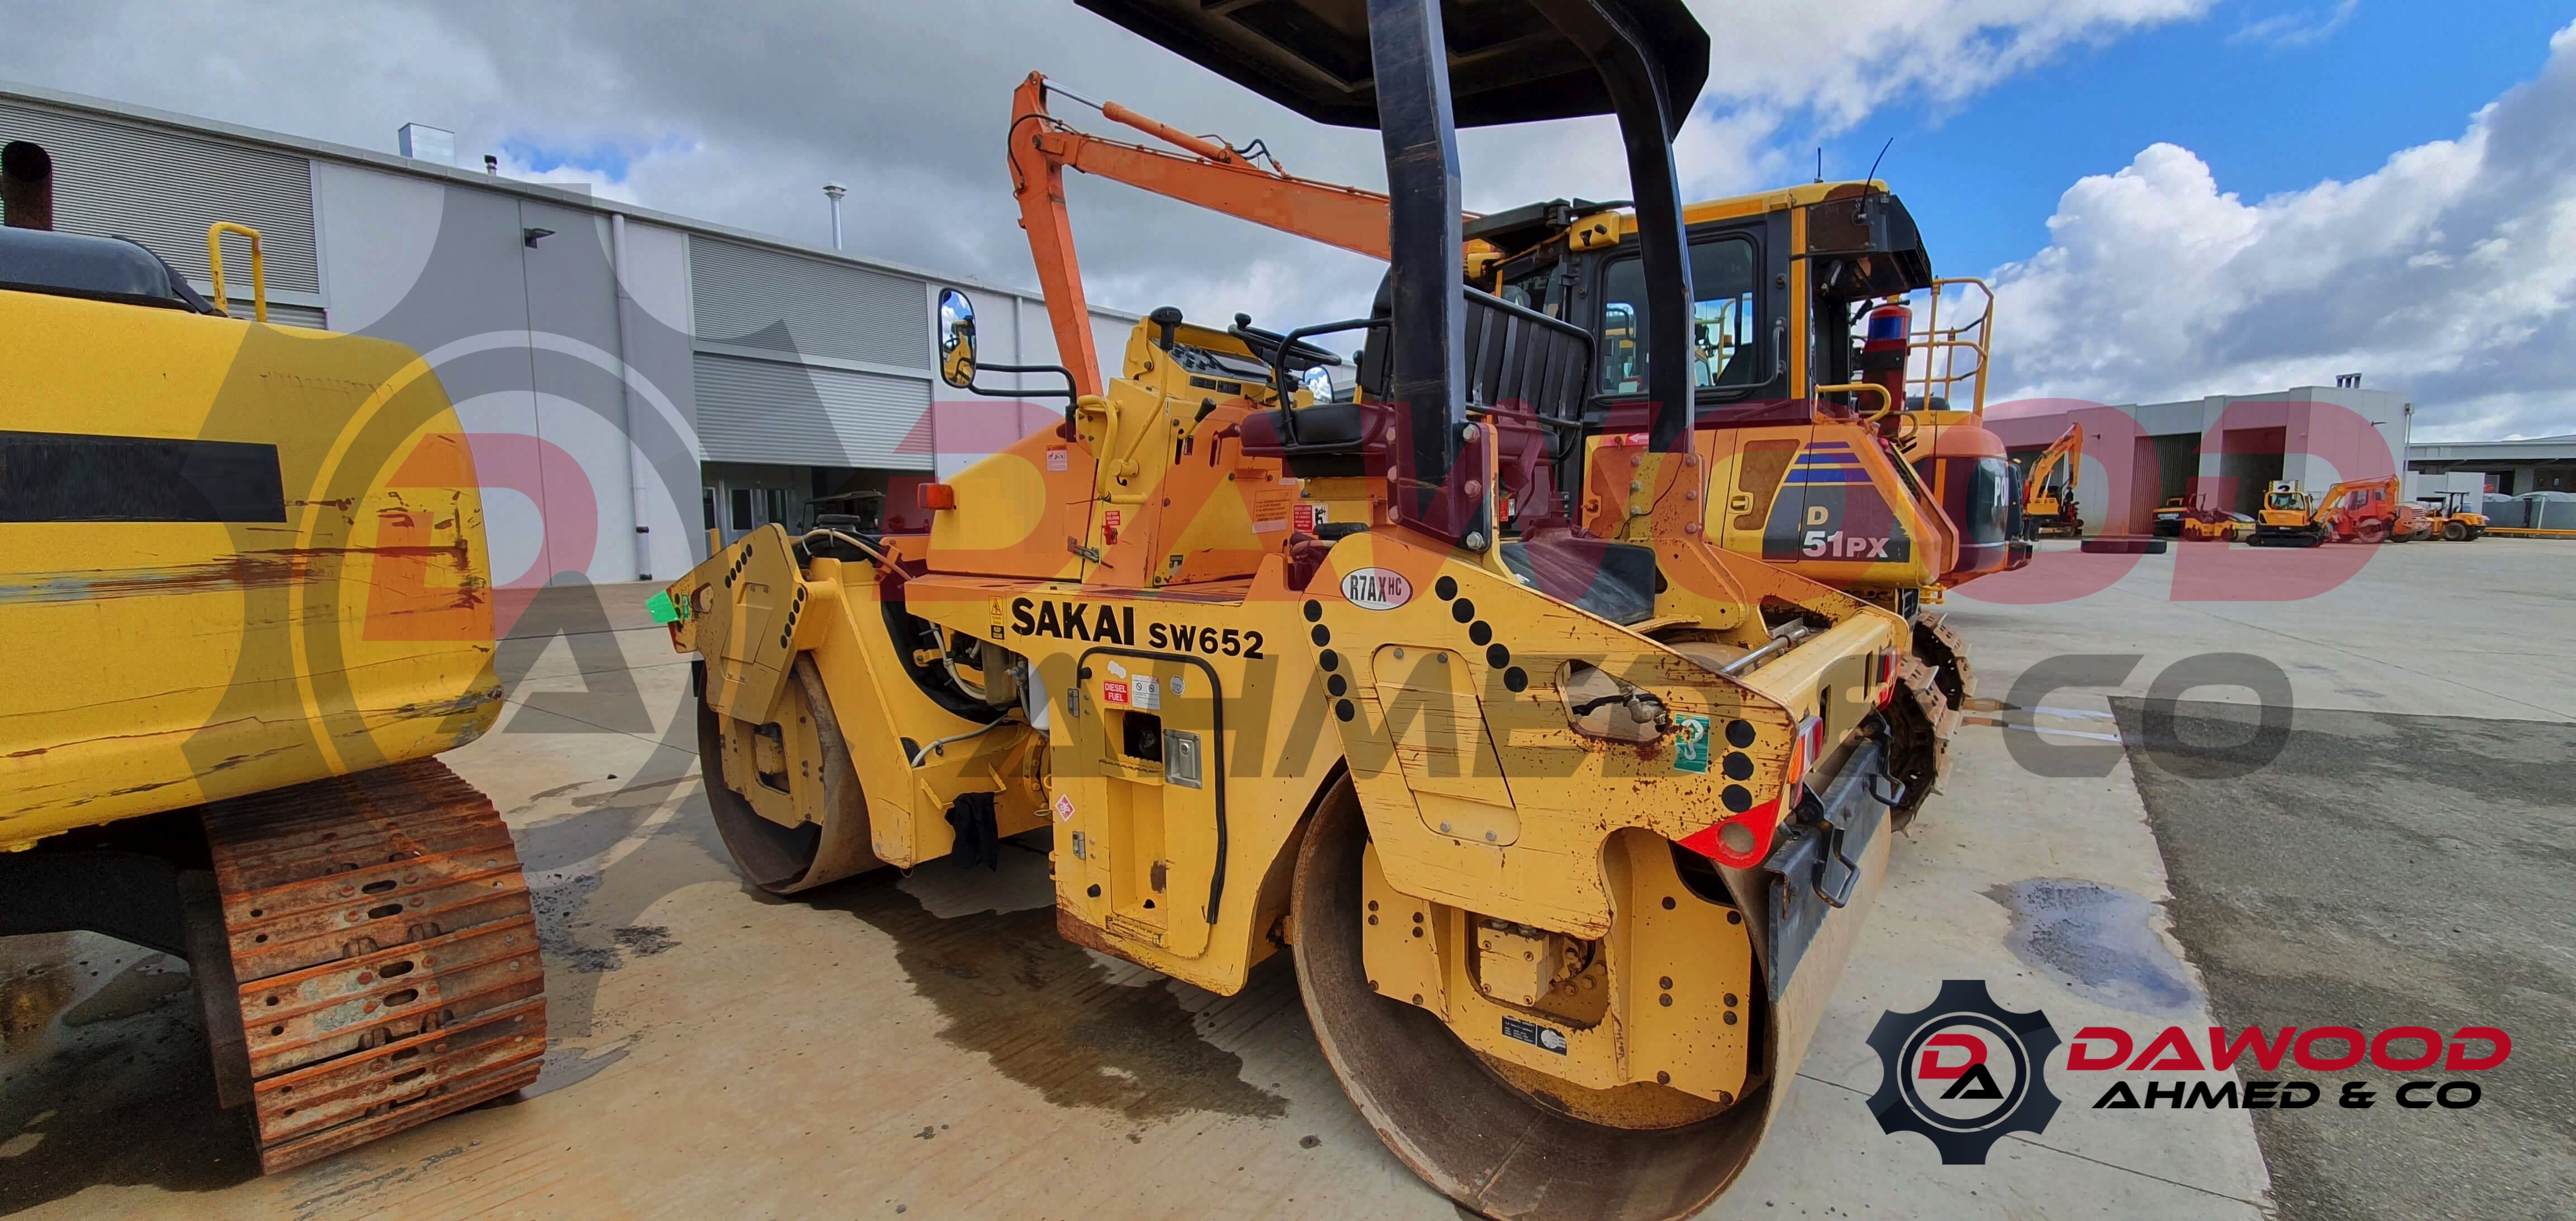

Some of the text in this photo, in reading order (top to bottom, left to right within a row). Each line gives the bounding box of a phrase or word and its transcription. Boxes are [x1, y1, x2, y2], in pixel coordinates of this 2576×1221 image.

[1807, 506, 1829, 526] D
[1802, 531, 1890, 557] 51PX
[1011, 597, 1264, 660] SAKAI SW652
[1105, 683, 1126, 693] DIESEL
[1108, 692, 1124, 702] FUEL
